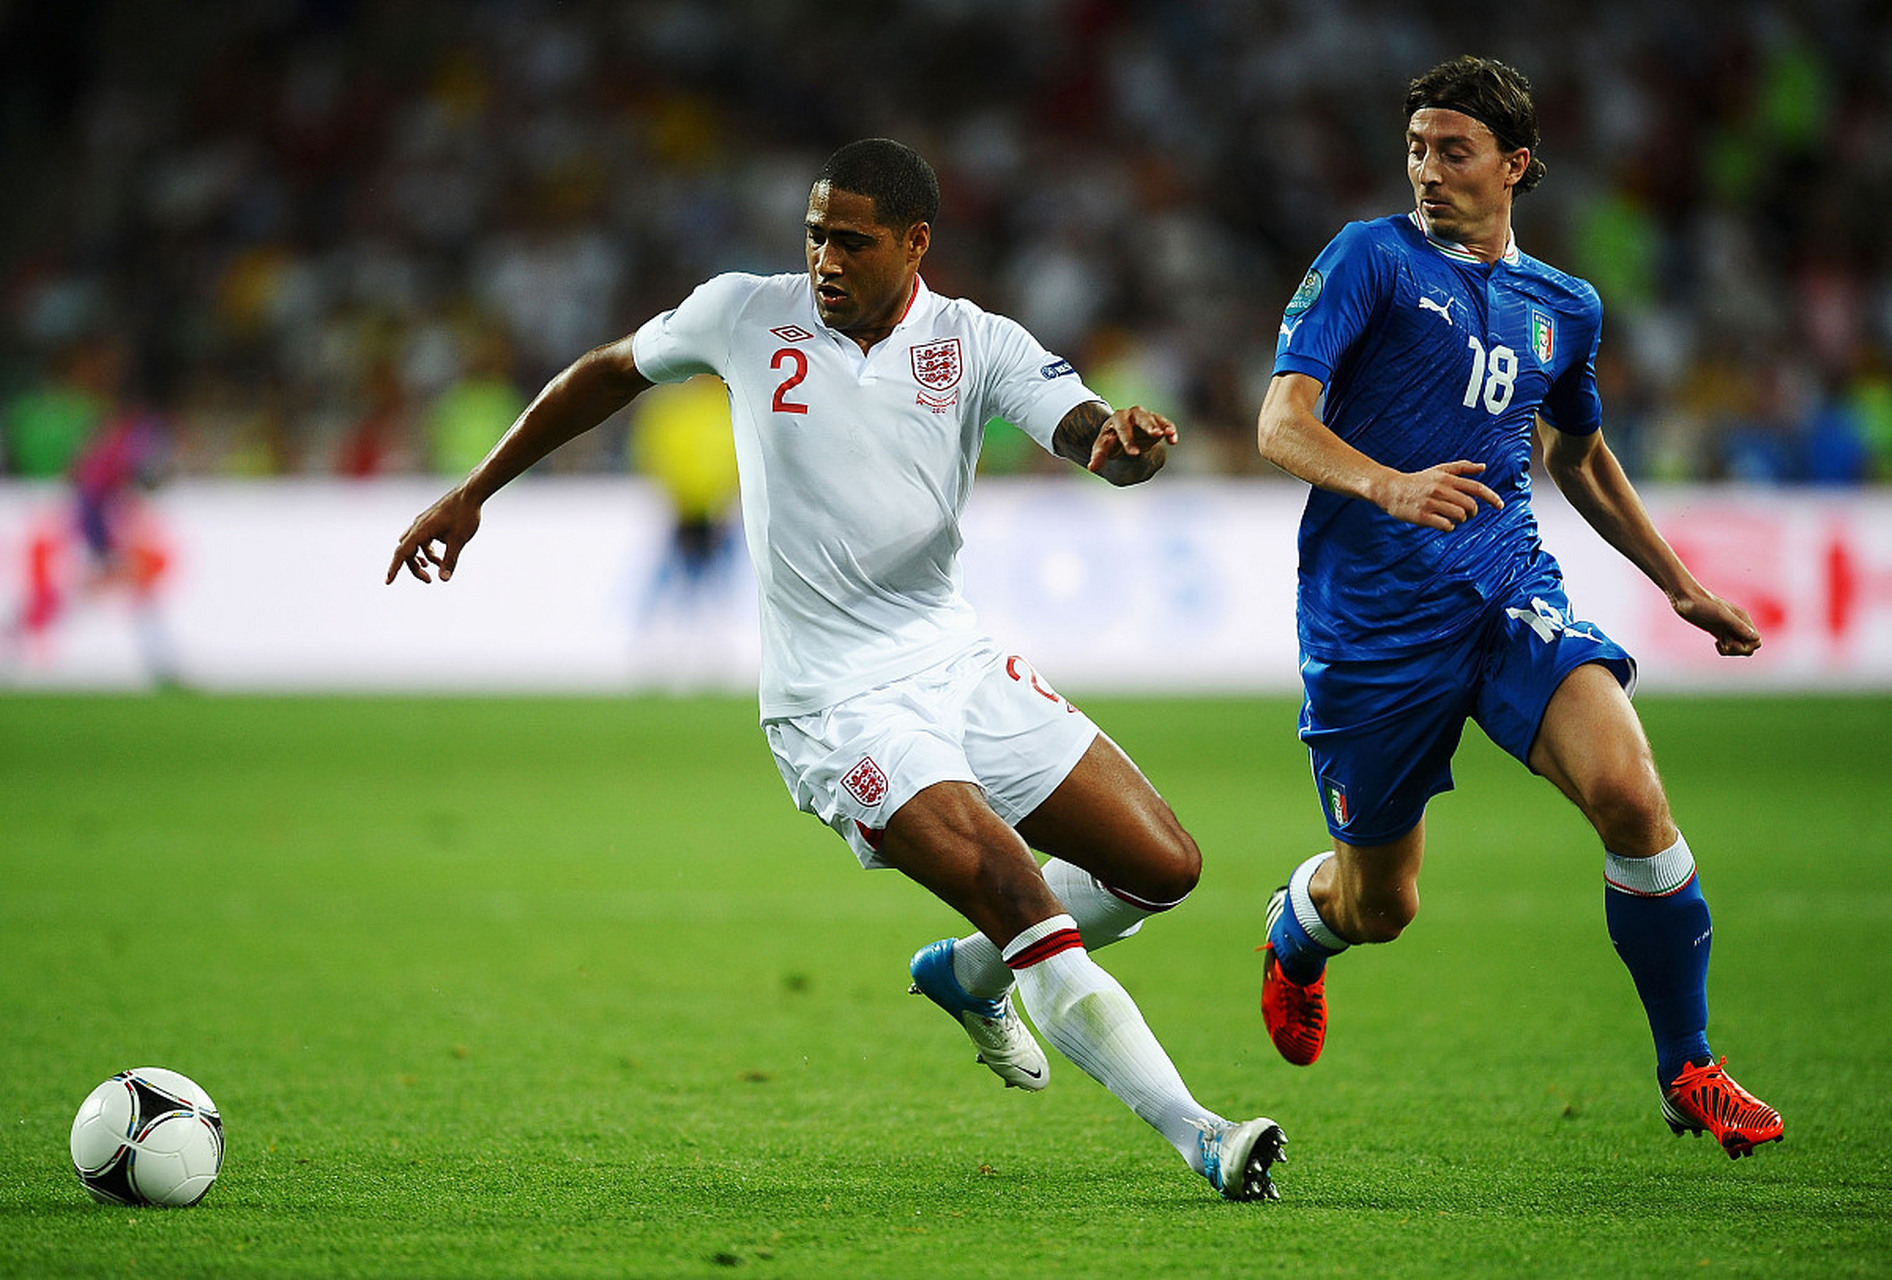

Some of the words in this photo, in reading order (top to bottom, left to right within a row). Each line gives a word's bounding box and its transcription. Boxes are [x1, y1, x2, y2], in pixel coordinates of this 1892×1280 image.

[769, 347, 809, 415] 2
[1463, 335, 1518, 416] 18
[1005, 655, 1060, 703] 2
